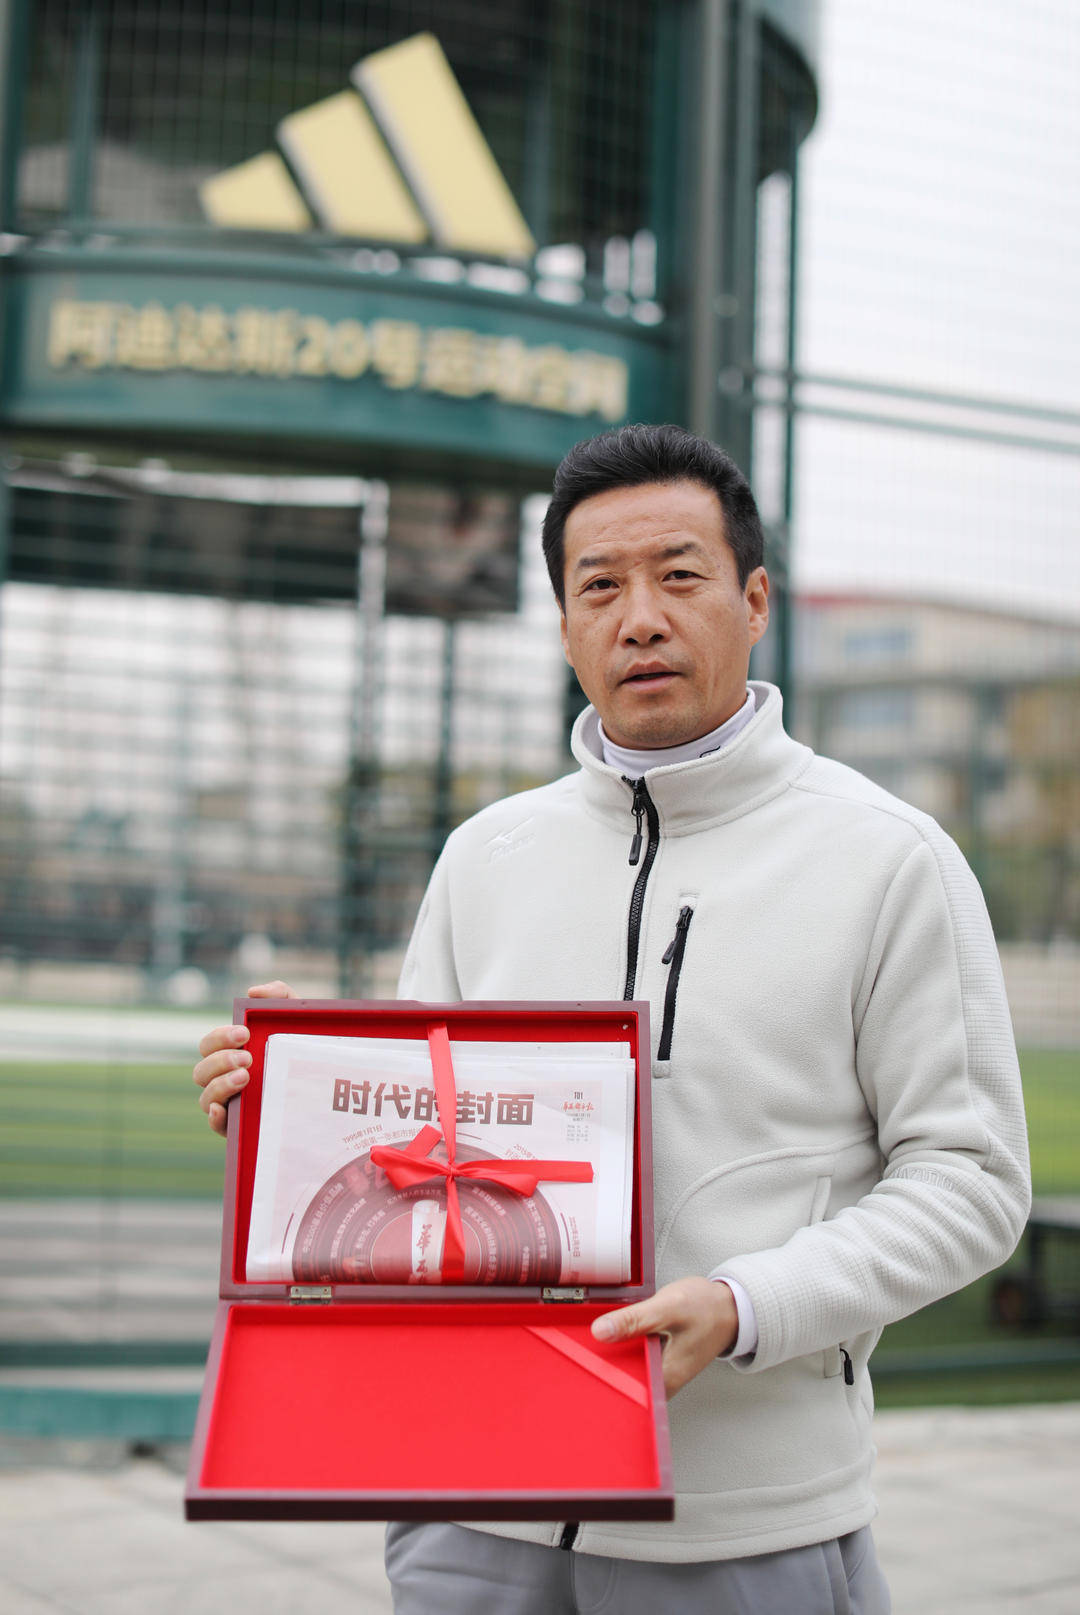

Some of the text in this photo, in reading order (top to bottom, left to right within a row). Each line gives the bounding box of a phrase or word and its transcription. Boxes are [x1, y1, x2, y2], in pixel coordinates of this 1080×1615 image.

[333, 1079, 534, 1125] 时代的封面
